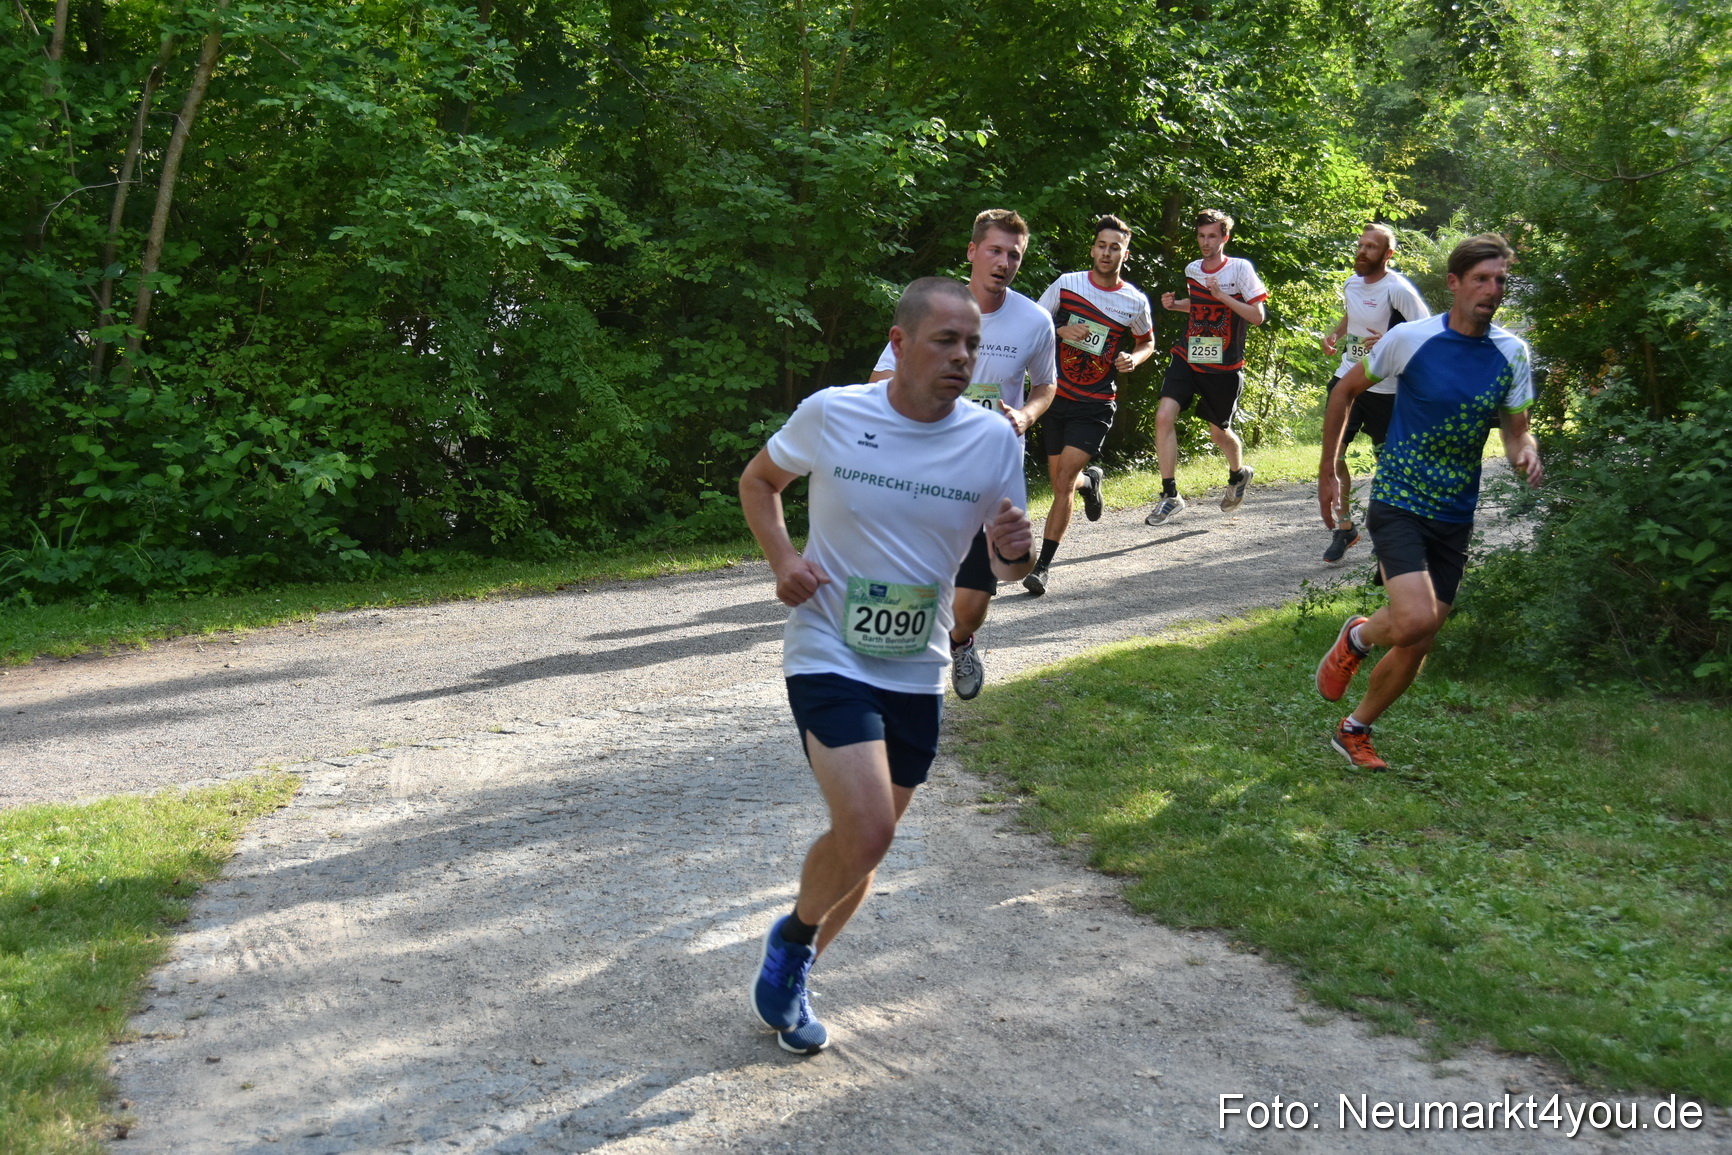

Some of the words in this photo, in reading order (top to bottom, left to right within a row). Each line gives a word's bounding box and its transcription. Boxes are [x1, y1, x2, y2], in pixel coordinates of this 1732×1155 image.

[1085, 332, 1100, 345] 60
[978, 344, 1018, 353] HWARZ
[1191, 345, 1218, 356] 2255
[857, 440, 879, 449] erima
[833, 466, 913, 492] RUPPRECHT
[920, 484, 981, 504] HOLZBAU
[854, 606, 925, 636] 2090
[862, 634, 883, 643] Barth
